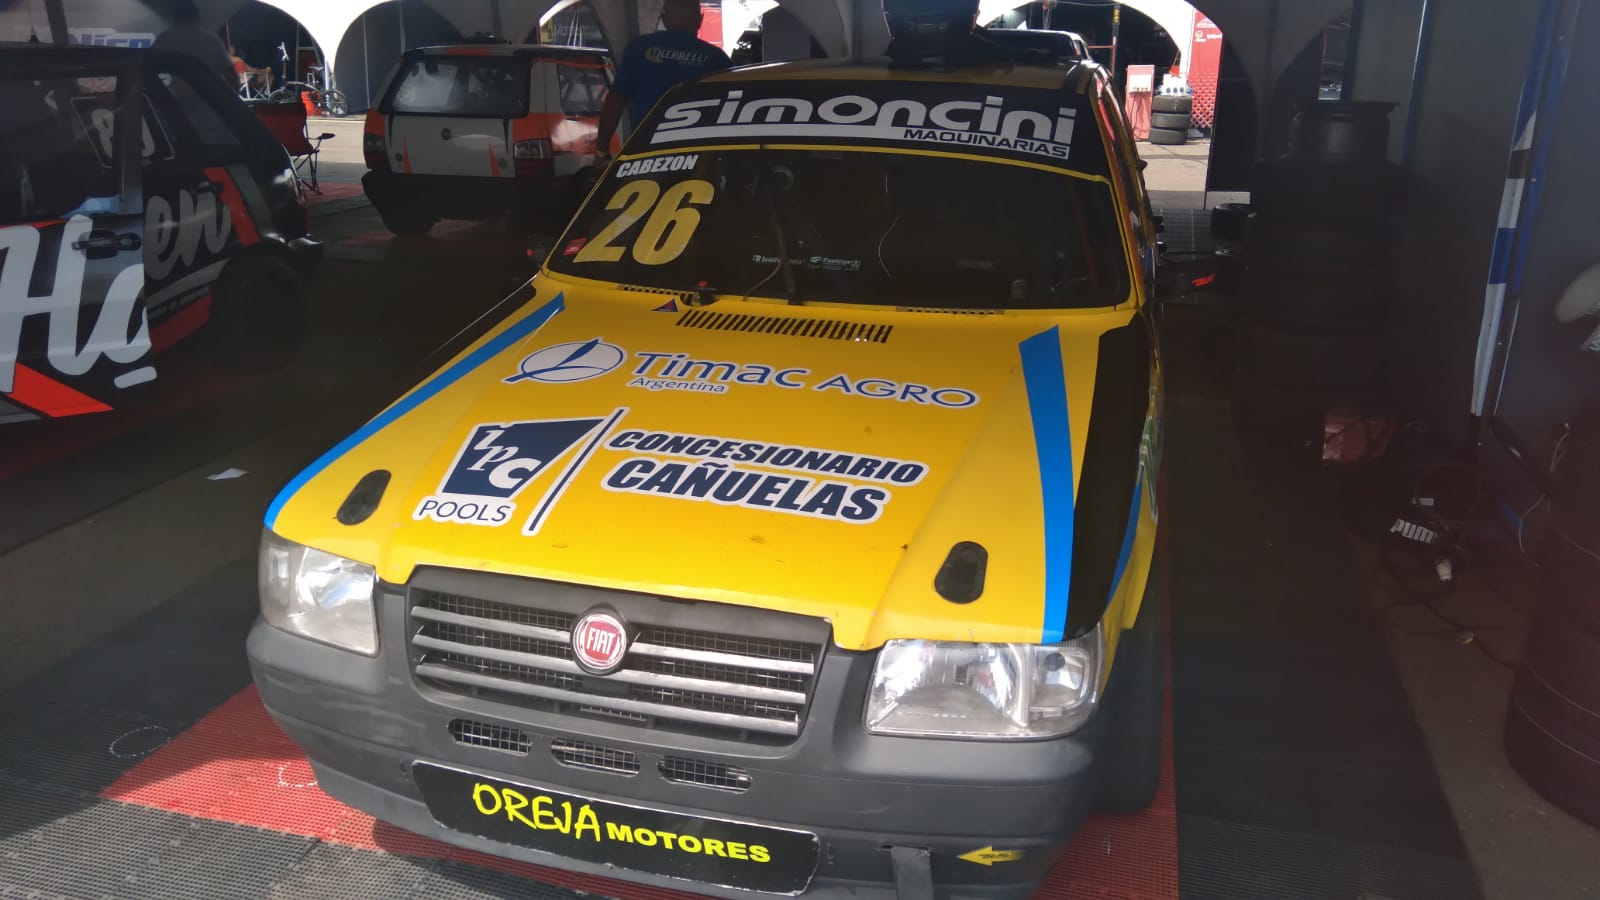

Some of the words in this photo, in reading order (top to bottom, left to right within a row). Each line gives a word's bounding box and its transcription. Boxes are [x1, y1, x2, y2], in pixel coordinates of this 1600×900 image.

[655, 90, 1077, 144] simoncini
[616, 155, 699, 178] CABEZON
[903, 129, 1068, 158] MAQUINARIAS
[573, 179, 715, 266] 26
[631, 377, 726, 394] Argentina
[635, 352, 808, 388] Timac
[816, 375, 977, 407] AGRO
[608, 431, 924, 483] CONCESIONARIO
[418, 499, 511, 522] POOLS
[606, 460, 886, 520] CAÑUELAS
[586, 627, 617, 655] FIAT
[473, 783, 600, 842] OREJA
[606, 822, 771, 863] MOTORES
